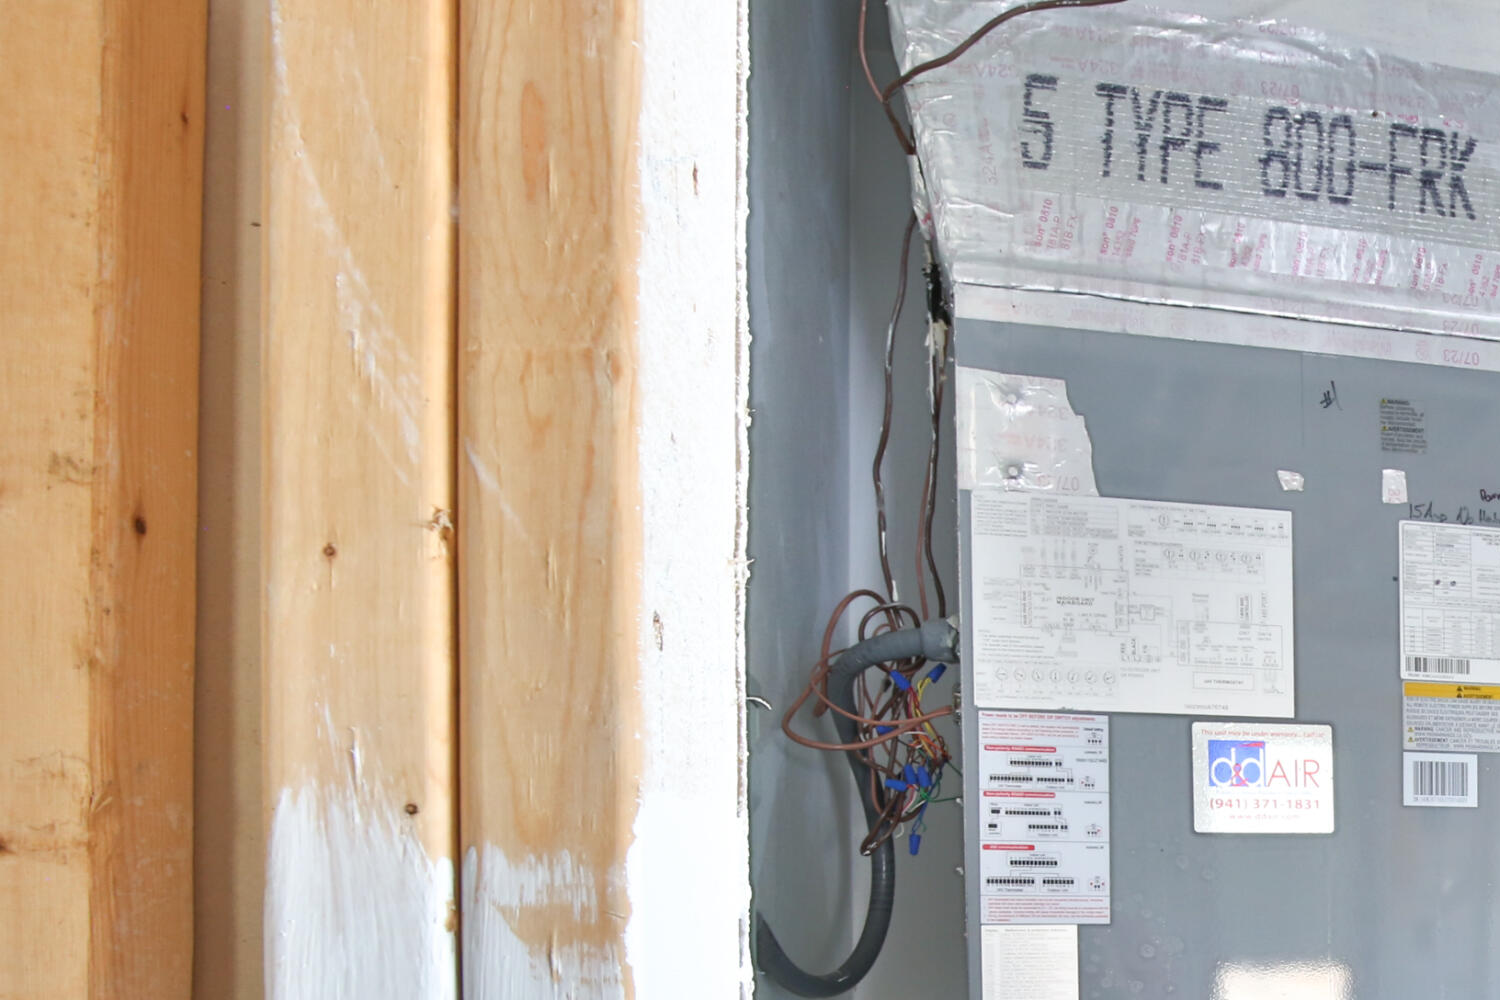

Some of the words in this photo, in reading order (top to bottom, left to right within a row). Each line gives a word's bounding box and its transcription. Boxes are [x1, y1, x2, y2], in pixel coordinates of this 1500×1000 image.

[1021, 73, 1059, 170] 5
[1096, 82, 1228, 191] TYPE
[1258, 106, 1478, 220] 800-FRK
[1267, 760, 1320, 787] AIR
